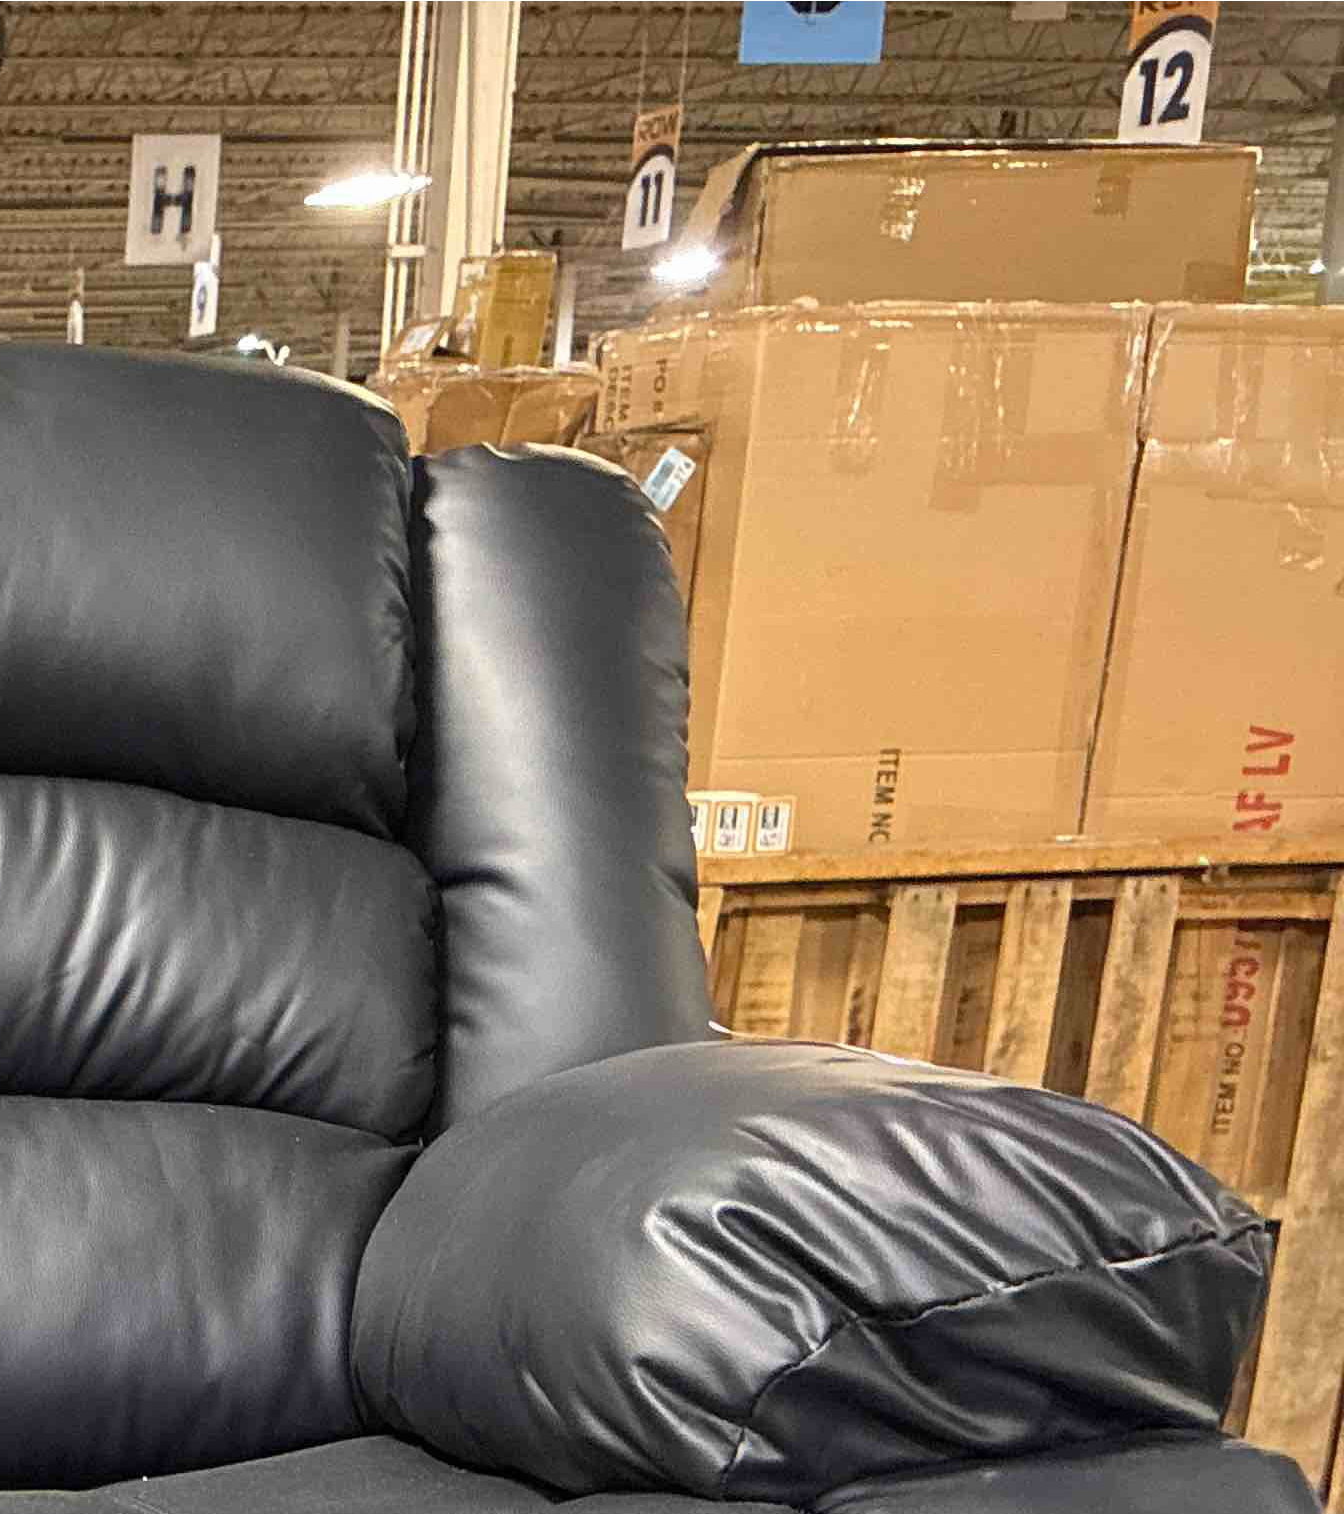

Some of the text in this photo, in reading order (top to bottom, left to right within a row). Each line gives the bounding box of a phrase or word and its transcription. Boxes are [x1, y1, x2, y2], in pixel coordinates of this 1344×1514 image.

[1139, 50, 1194, 127] 12
[638, 111, 678, 141] ROW
[150, 164, 197, 235] H
[639, 169, 664, 227] 11
[874, 748, 902, 805] ITEM
[1213, 1080, 1237, 1135] ITEM
